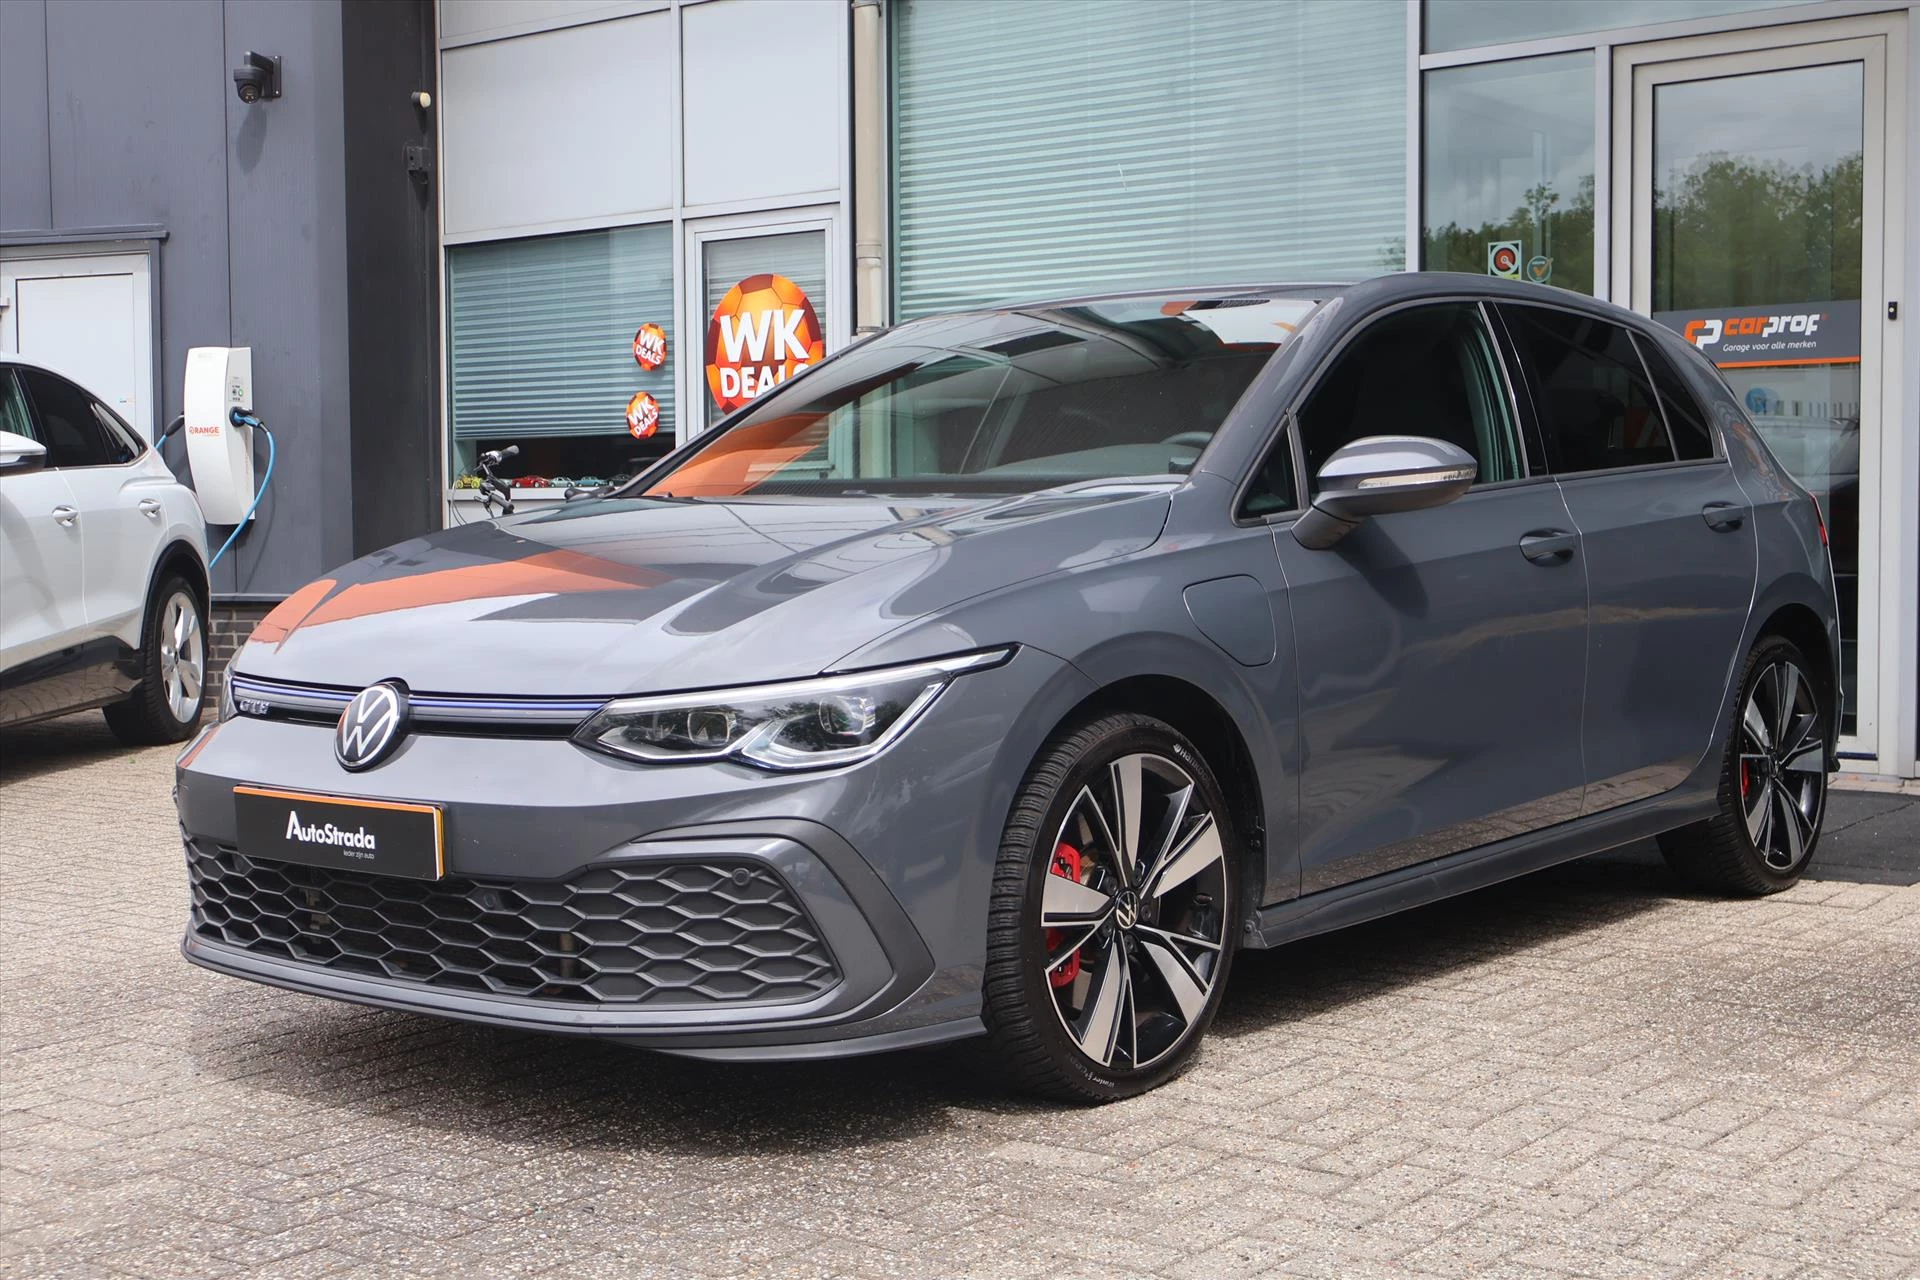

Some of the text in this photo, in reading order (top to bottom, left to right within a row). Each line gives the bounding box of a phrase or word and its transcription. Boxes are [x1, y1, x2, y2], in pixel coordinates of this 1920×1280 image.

[719, 309, 809, 362] WK
[1724, 314, 1820, 338] carprof
[636, 345, 662, 365] DEALS
[640, 330, 665, 355] WK
[1723, 340, 1817, 352] Garage voor alle merken
[628, 396, 654, 425] WK
[634, 408, 658, 435] DEALS
[189, 426, 220, 435] ORANGE
[286, 810, 376, 849] AutoStrada
